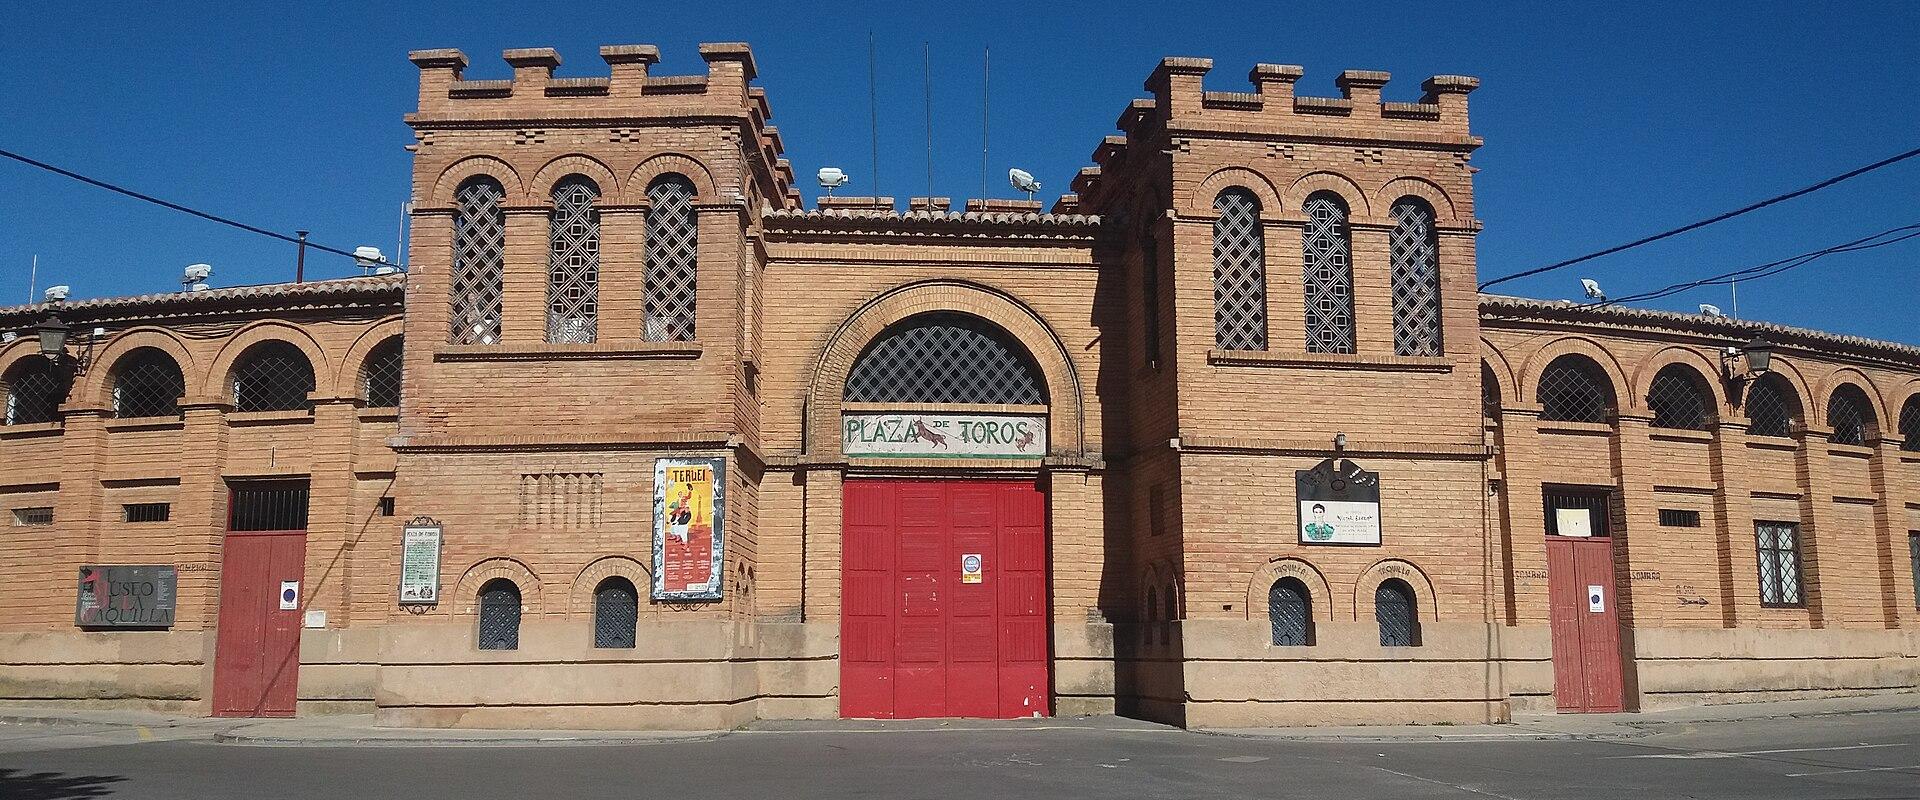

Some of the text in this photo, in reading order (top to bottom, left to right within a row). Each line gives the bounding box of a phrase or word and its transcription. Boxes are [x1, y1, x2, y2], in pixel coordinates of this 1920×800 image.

[847, 419, 1027, 444] PLAZA DE TOROS
[1274, 564, 1307, 576] TAQUILLA
[1377, 565, 1410, 576] TAQUILLA
